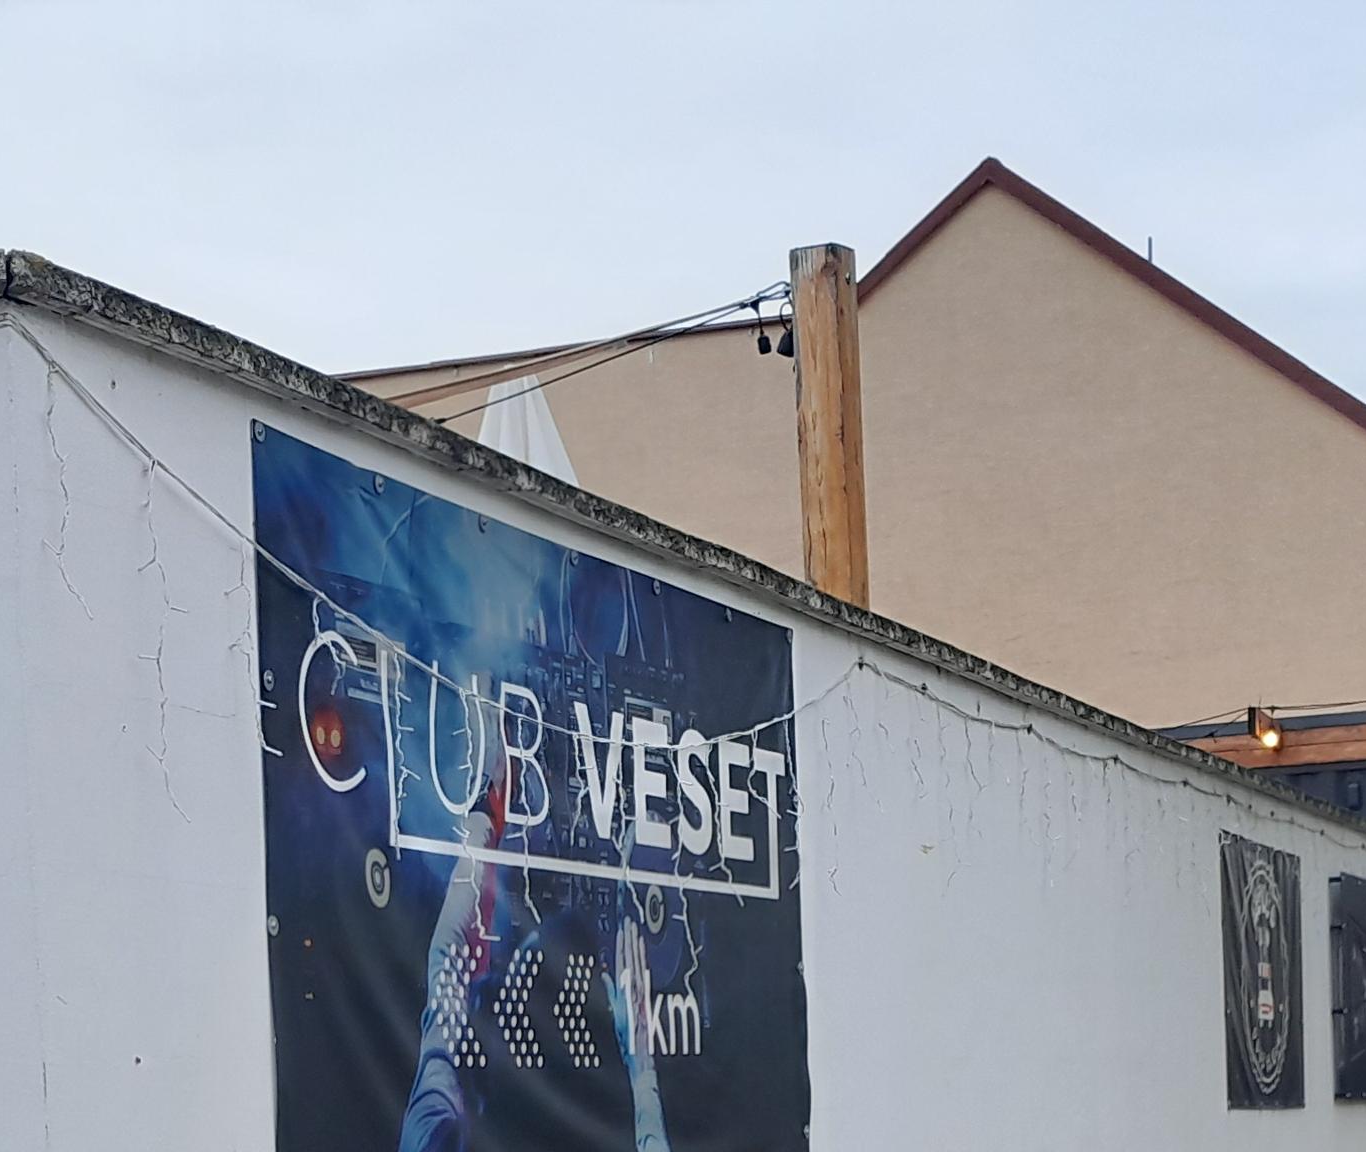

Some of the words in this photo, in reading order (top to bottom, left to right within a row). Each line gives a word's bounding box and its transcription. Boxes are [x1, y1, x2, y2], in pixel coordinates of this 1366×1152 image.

[298, 630, 550, 847] CLUB
[573, 701, 786, 868] VESET
[620, 967, 636, 1056] 1
[644, 968, 701, 1056] km
